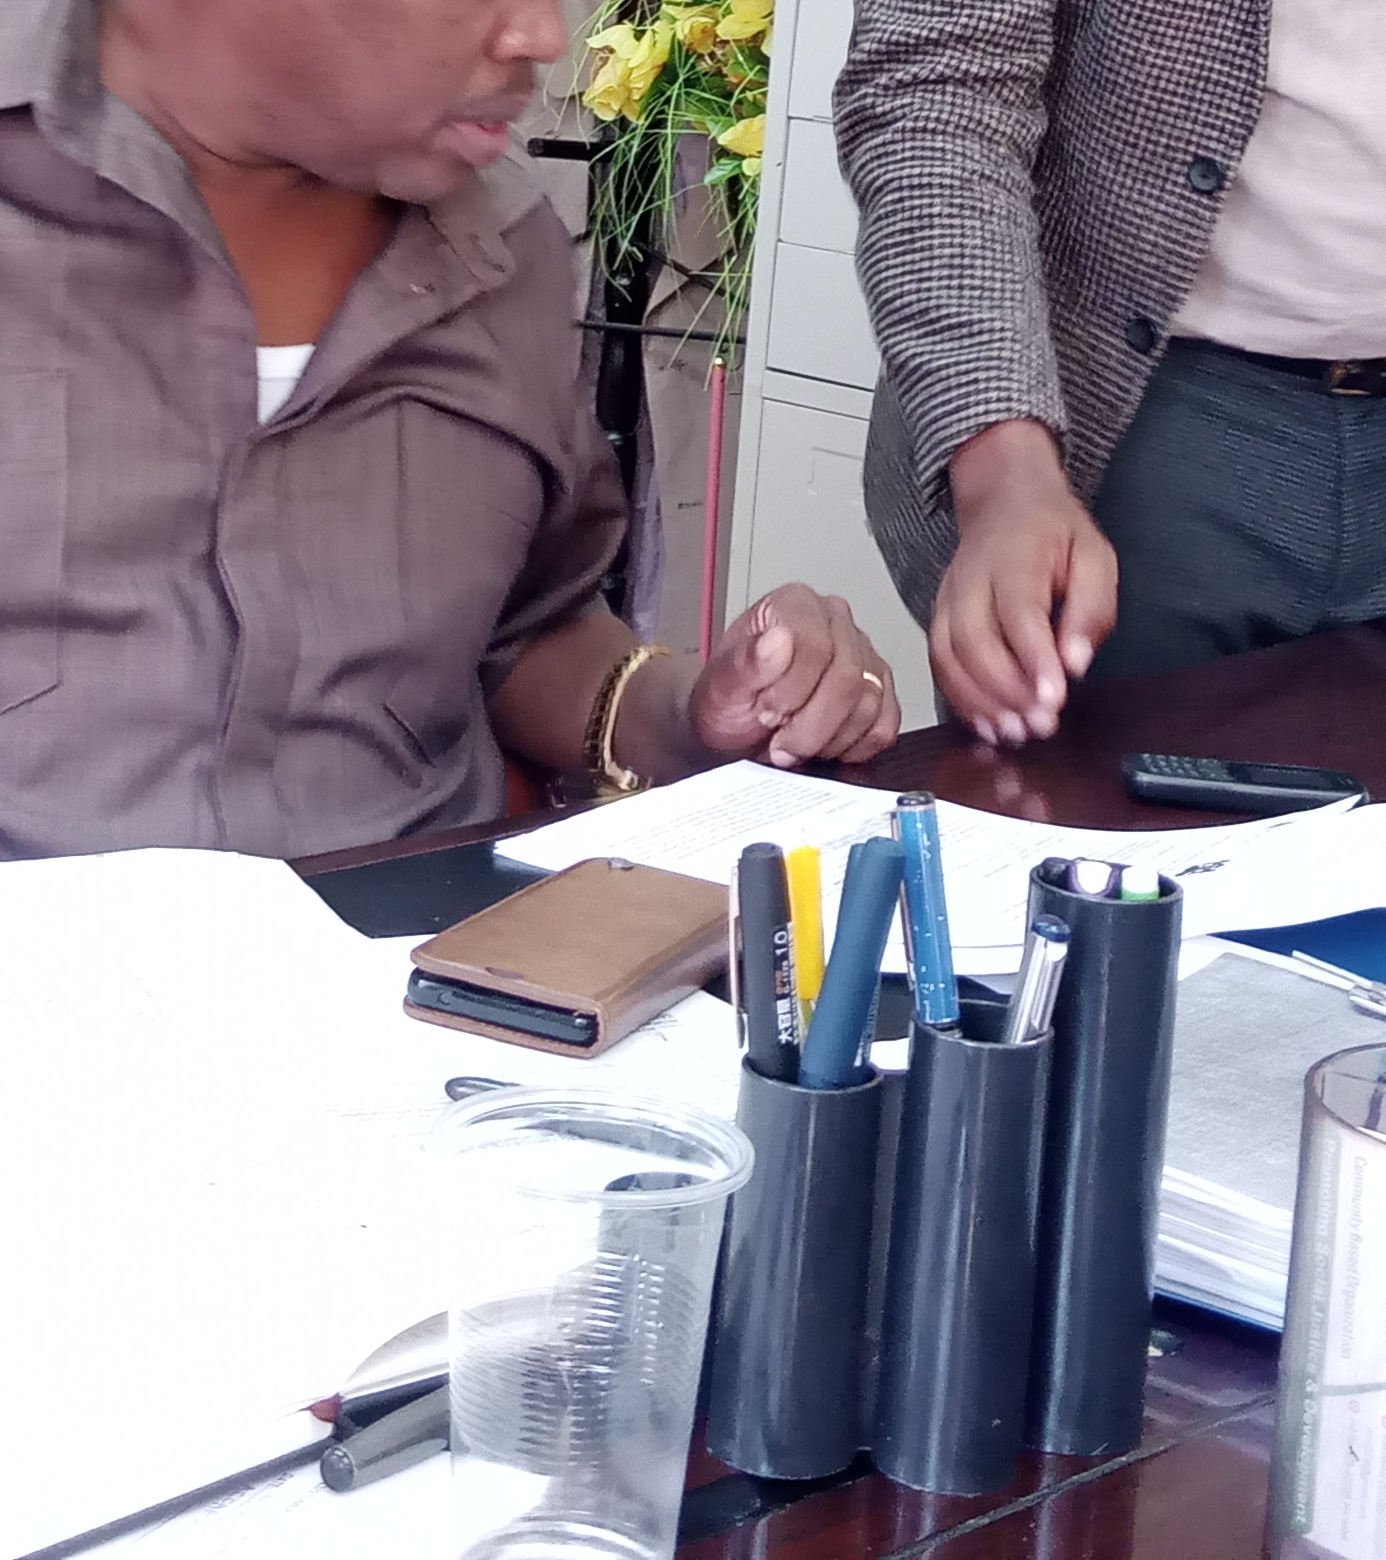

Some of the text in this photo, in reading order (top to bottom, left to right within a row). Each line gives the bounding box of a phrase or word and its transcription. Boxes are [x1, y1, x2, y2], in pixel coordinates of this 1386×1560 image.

[1295, 1138, 1336, 1525] Promoting Social Justice & Development
[1339, 1155, 1368, 1359] Community Based Organization
